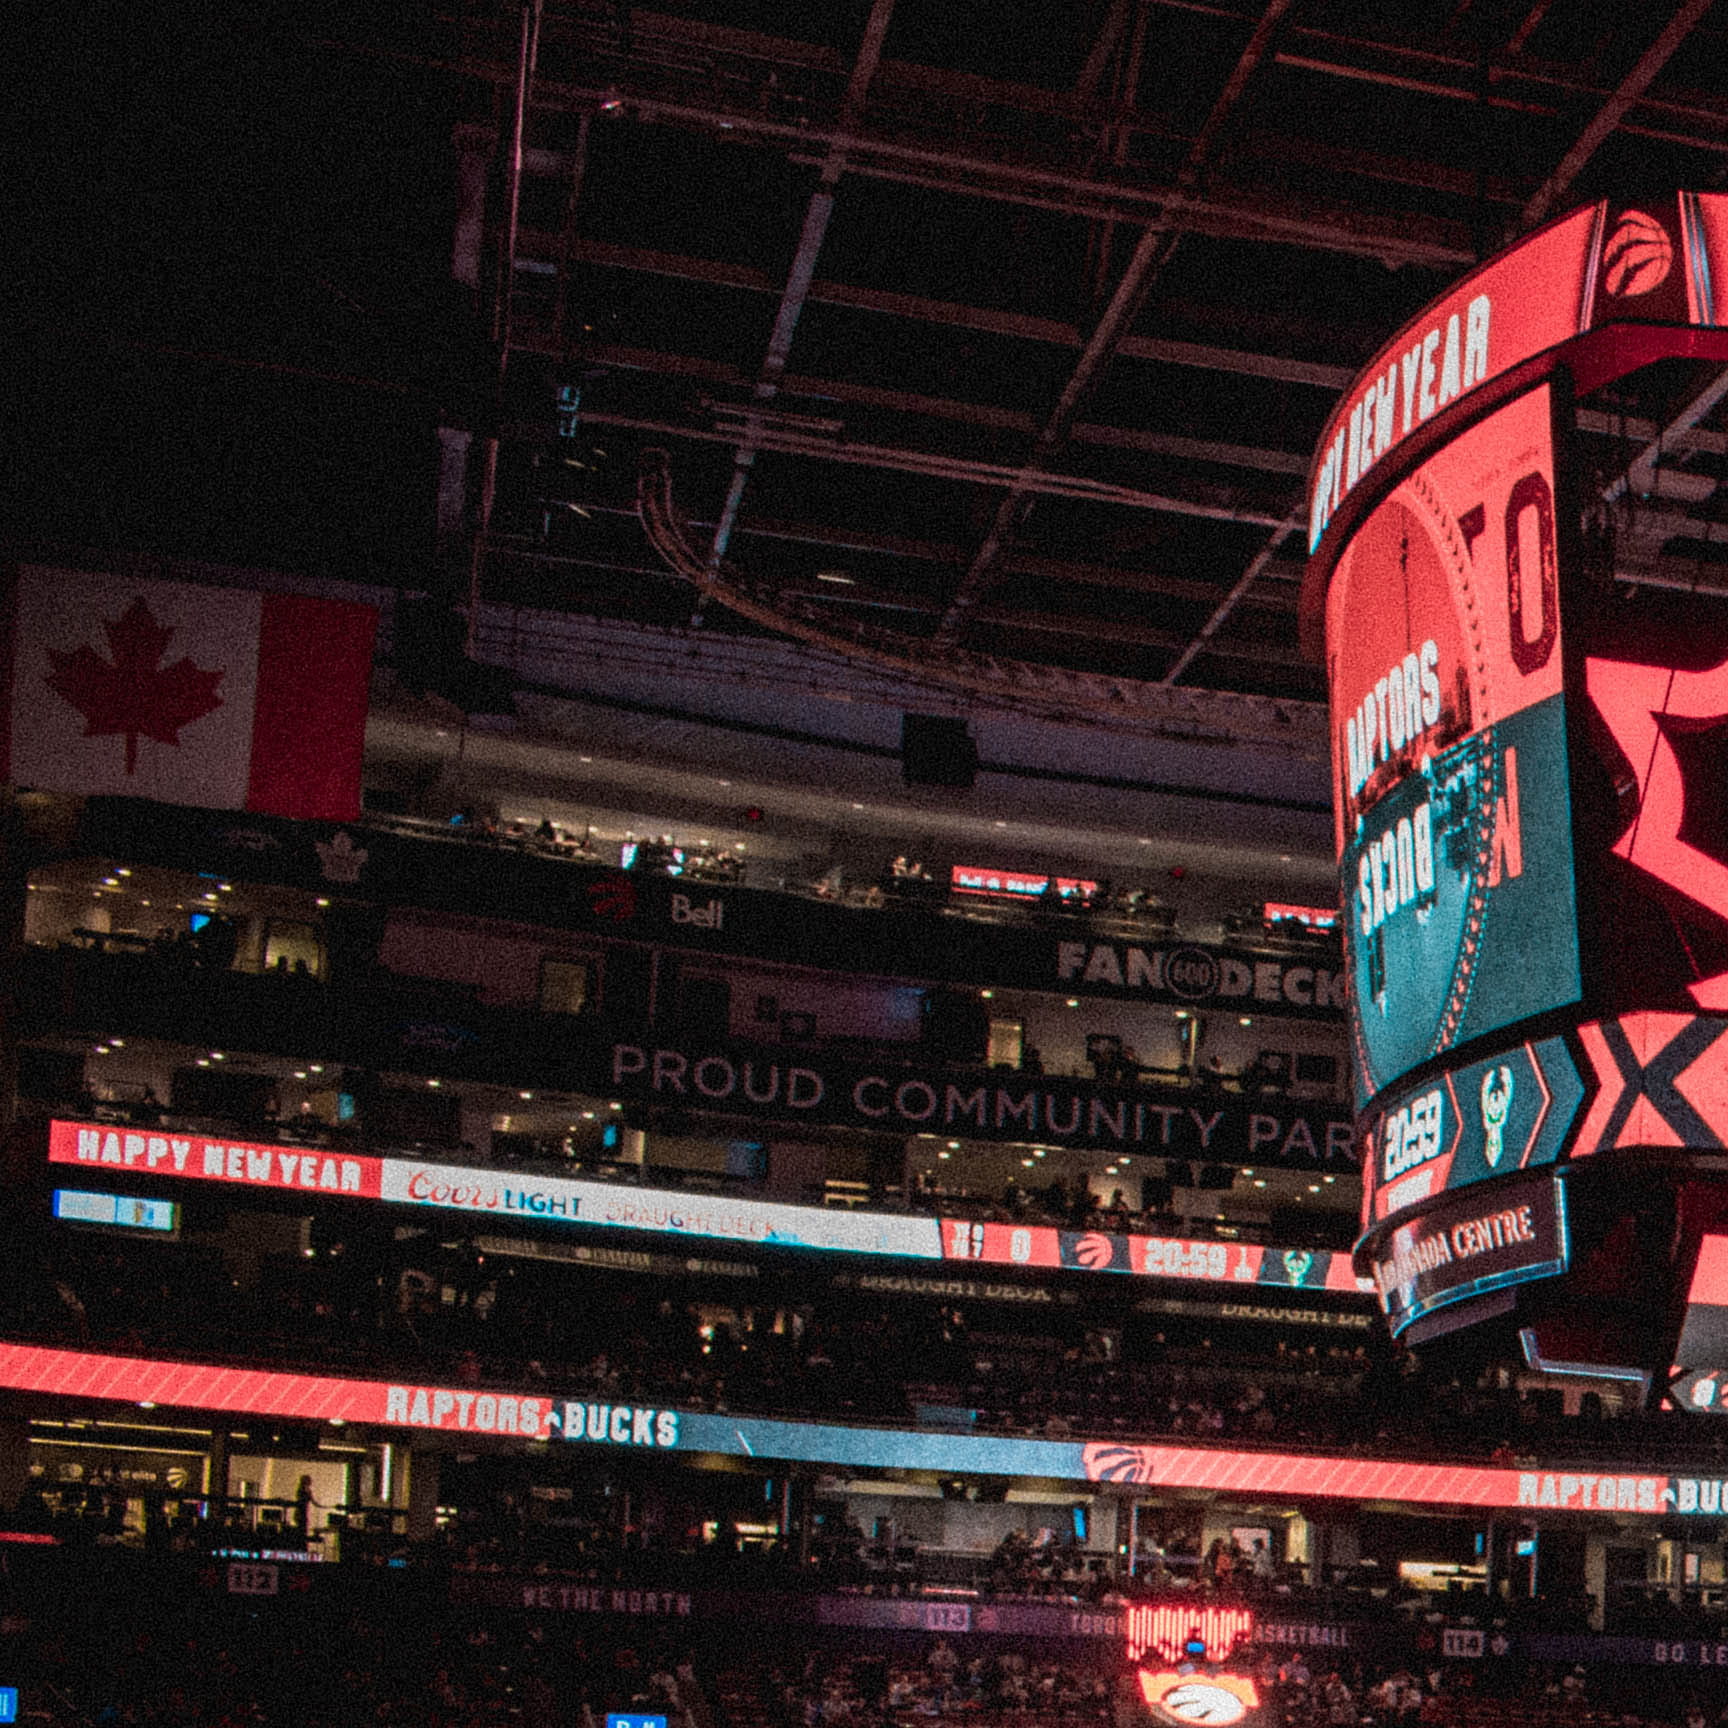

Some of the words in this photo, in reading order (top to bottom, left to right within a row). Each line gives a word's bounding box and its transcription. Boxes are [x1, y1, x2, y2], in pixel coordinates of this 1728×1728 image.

[1400, 294, 1491, 432] YEAR
[671, 892, 724, 929] Bell
[1057, 940, 1166, 990] FAN
[1218, 957, 1345, 1009] DECK
[613, 1043, 824, 1109] PROUD
[853, 1075, 1225, 1149] COMMUNITY
[1250, 1113, 1357, 1161] PAR
[76, 1129, 191, 1172] HAPPY
[202, 1142, 277, 1185] NEW
[278, 1154, 362, 1193] YEAR
[1384, 1088, 1447, 1187] 20:59
[406, 1169, 499, 1210] Coors
[504, 1189, 583, 1219] LIGHT
[1144, 1238, 1228, 1279] 20:59
[1452, 1204, 1536, 1261] CENTRE
[386, 1385, 543, 1436] RAPTORS
[563, 1402, 680, 1447] BUCKS
[1518, 1471, 1658, 1515] RAPTORS
